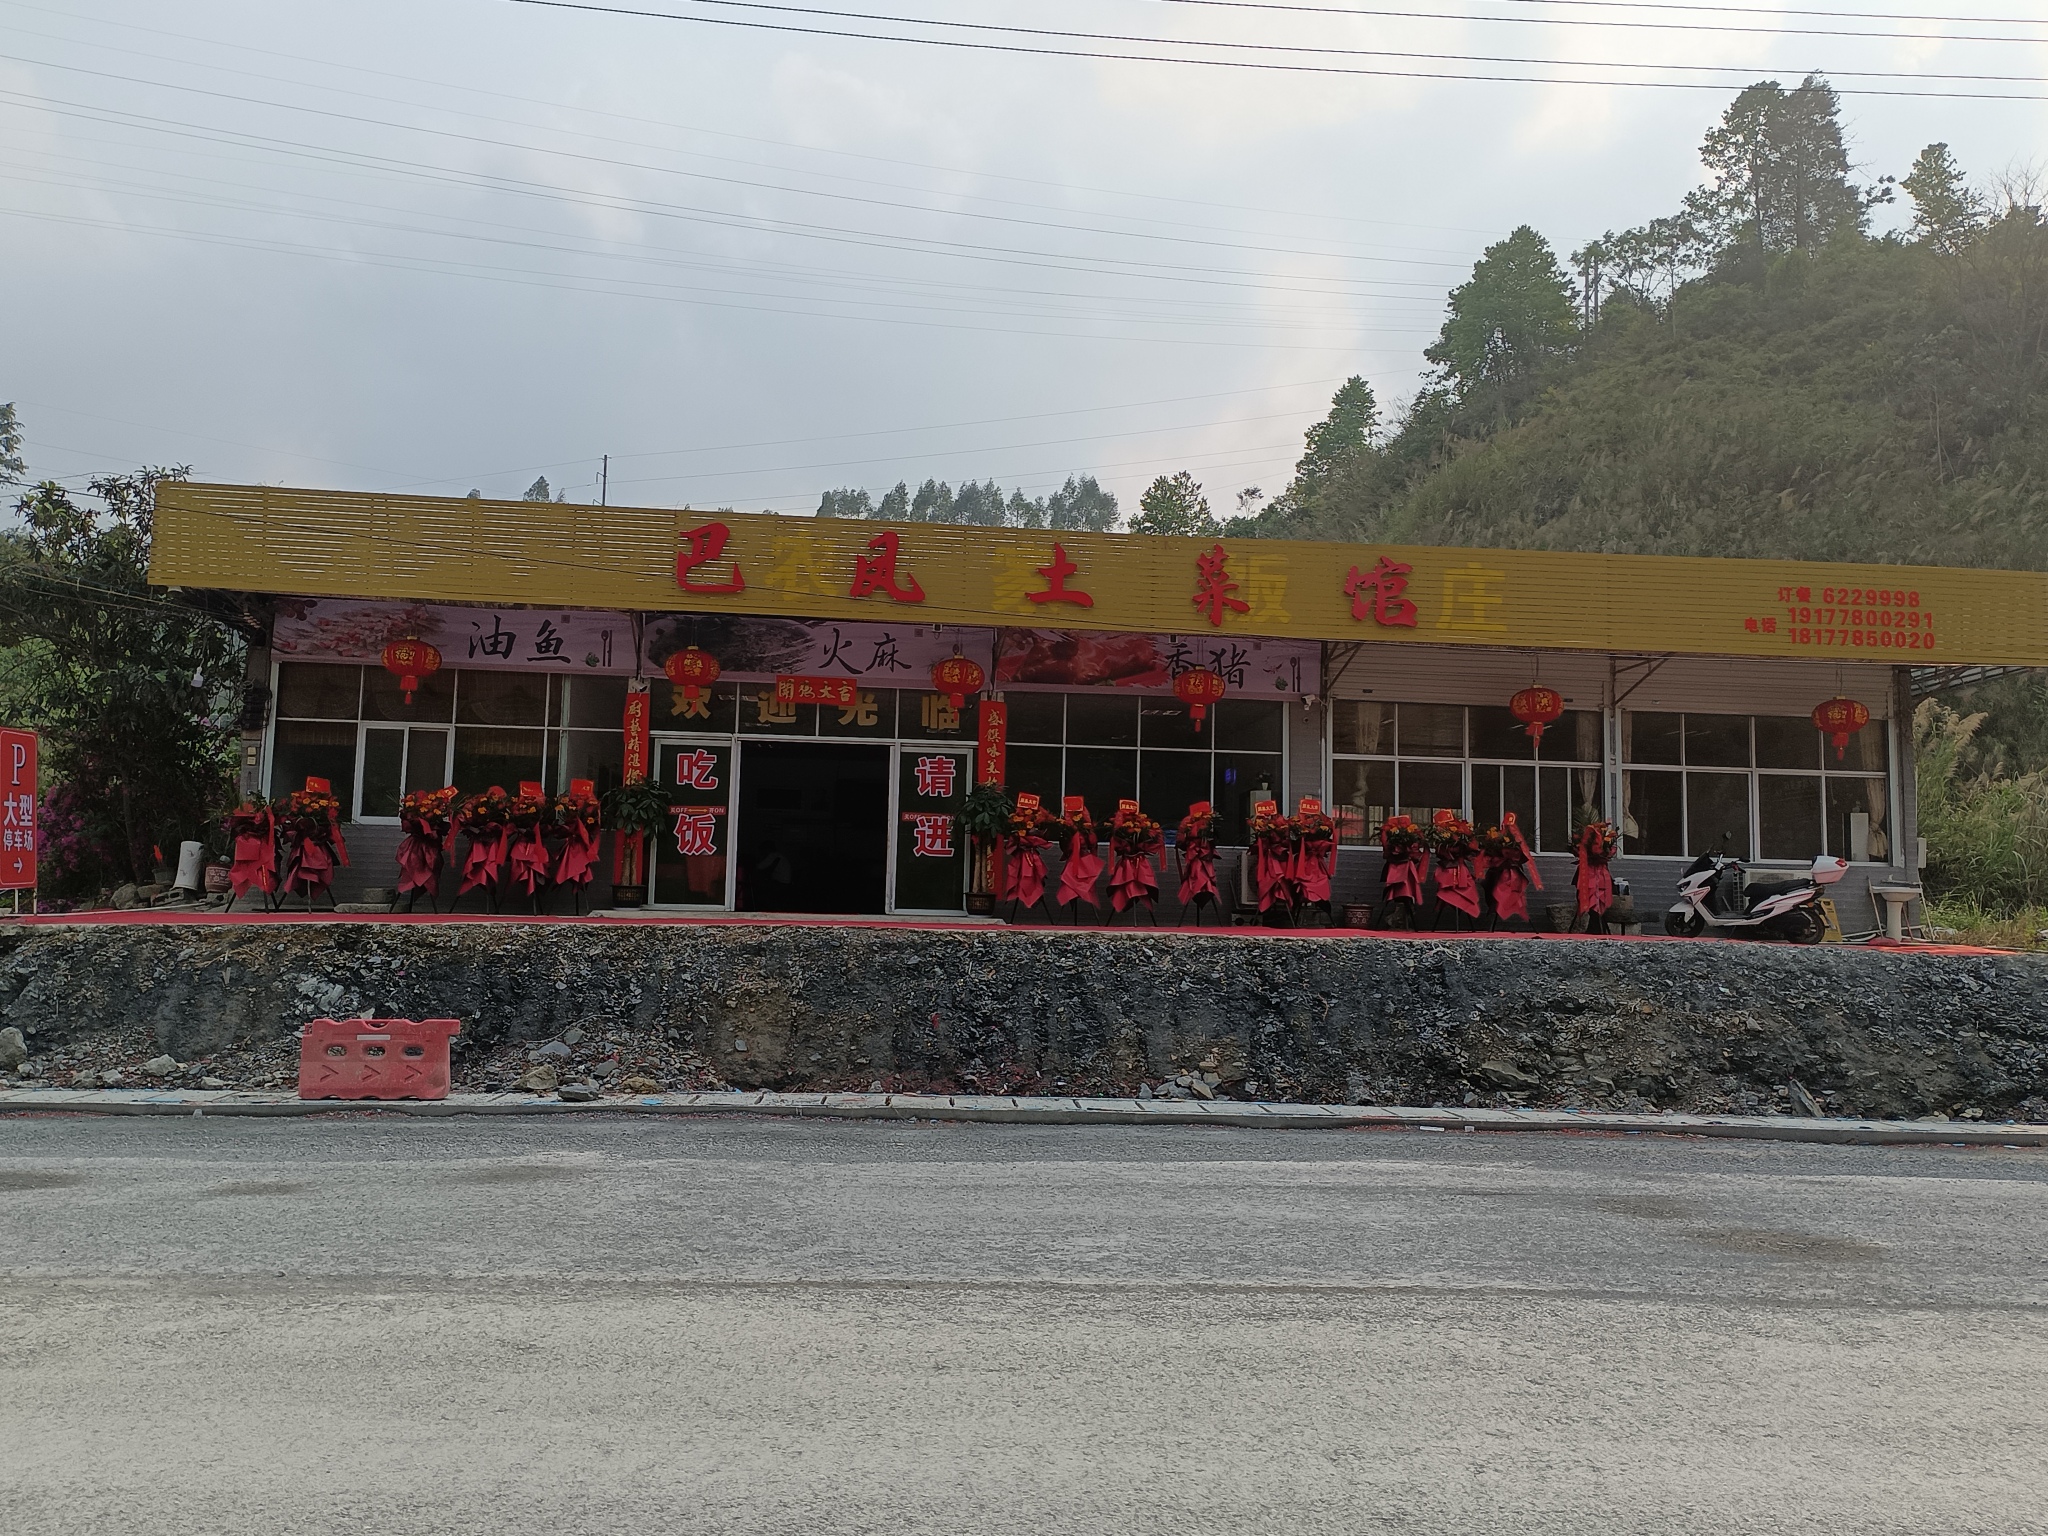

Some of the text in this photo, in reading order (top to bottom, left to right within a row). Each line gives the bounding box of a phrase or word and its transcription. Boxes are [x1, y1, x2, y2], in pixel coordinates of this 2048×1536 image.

[675, 521, 1419, 629] 巴凤土菜馆
[1823, 587, 1920, 608] 6229998
[1788, 606, 1933, 629] 19177800291
[468, 615, 572, 664] 油鱼
[818, 628, 912, 675] 火麻
[1788, 627, 1935, 650] 18177850020
[11, 743, 26, 785] P
[3, 792, 33, 827] 大型
[3, 828, 33, 852] 停车场
